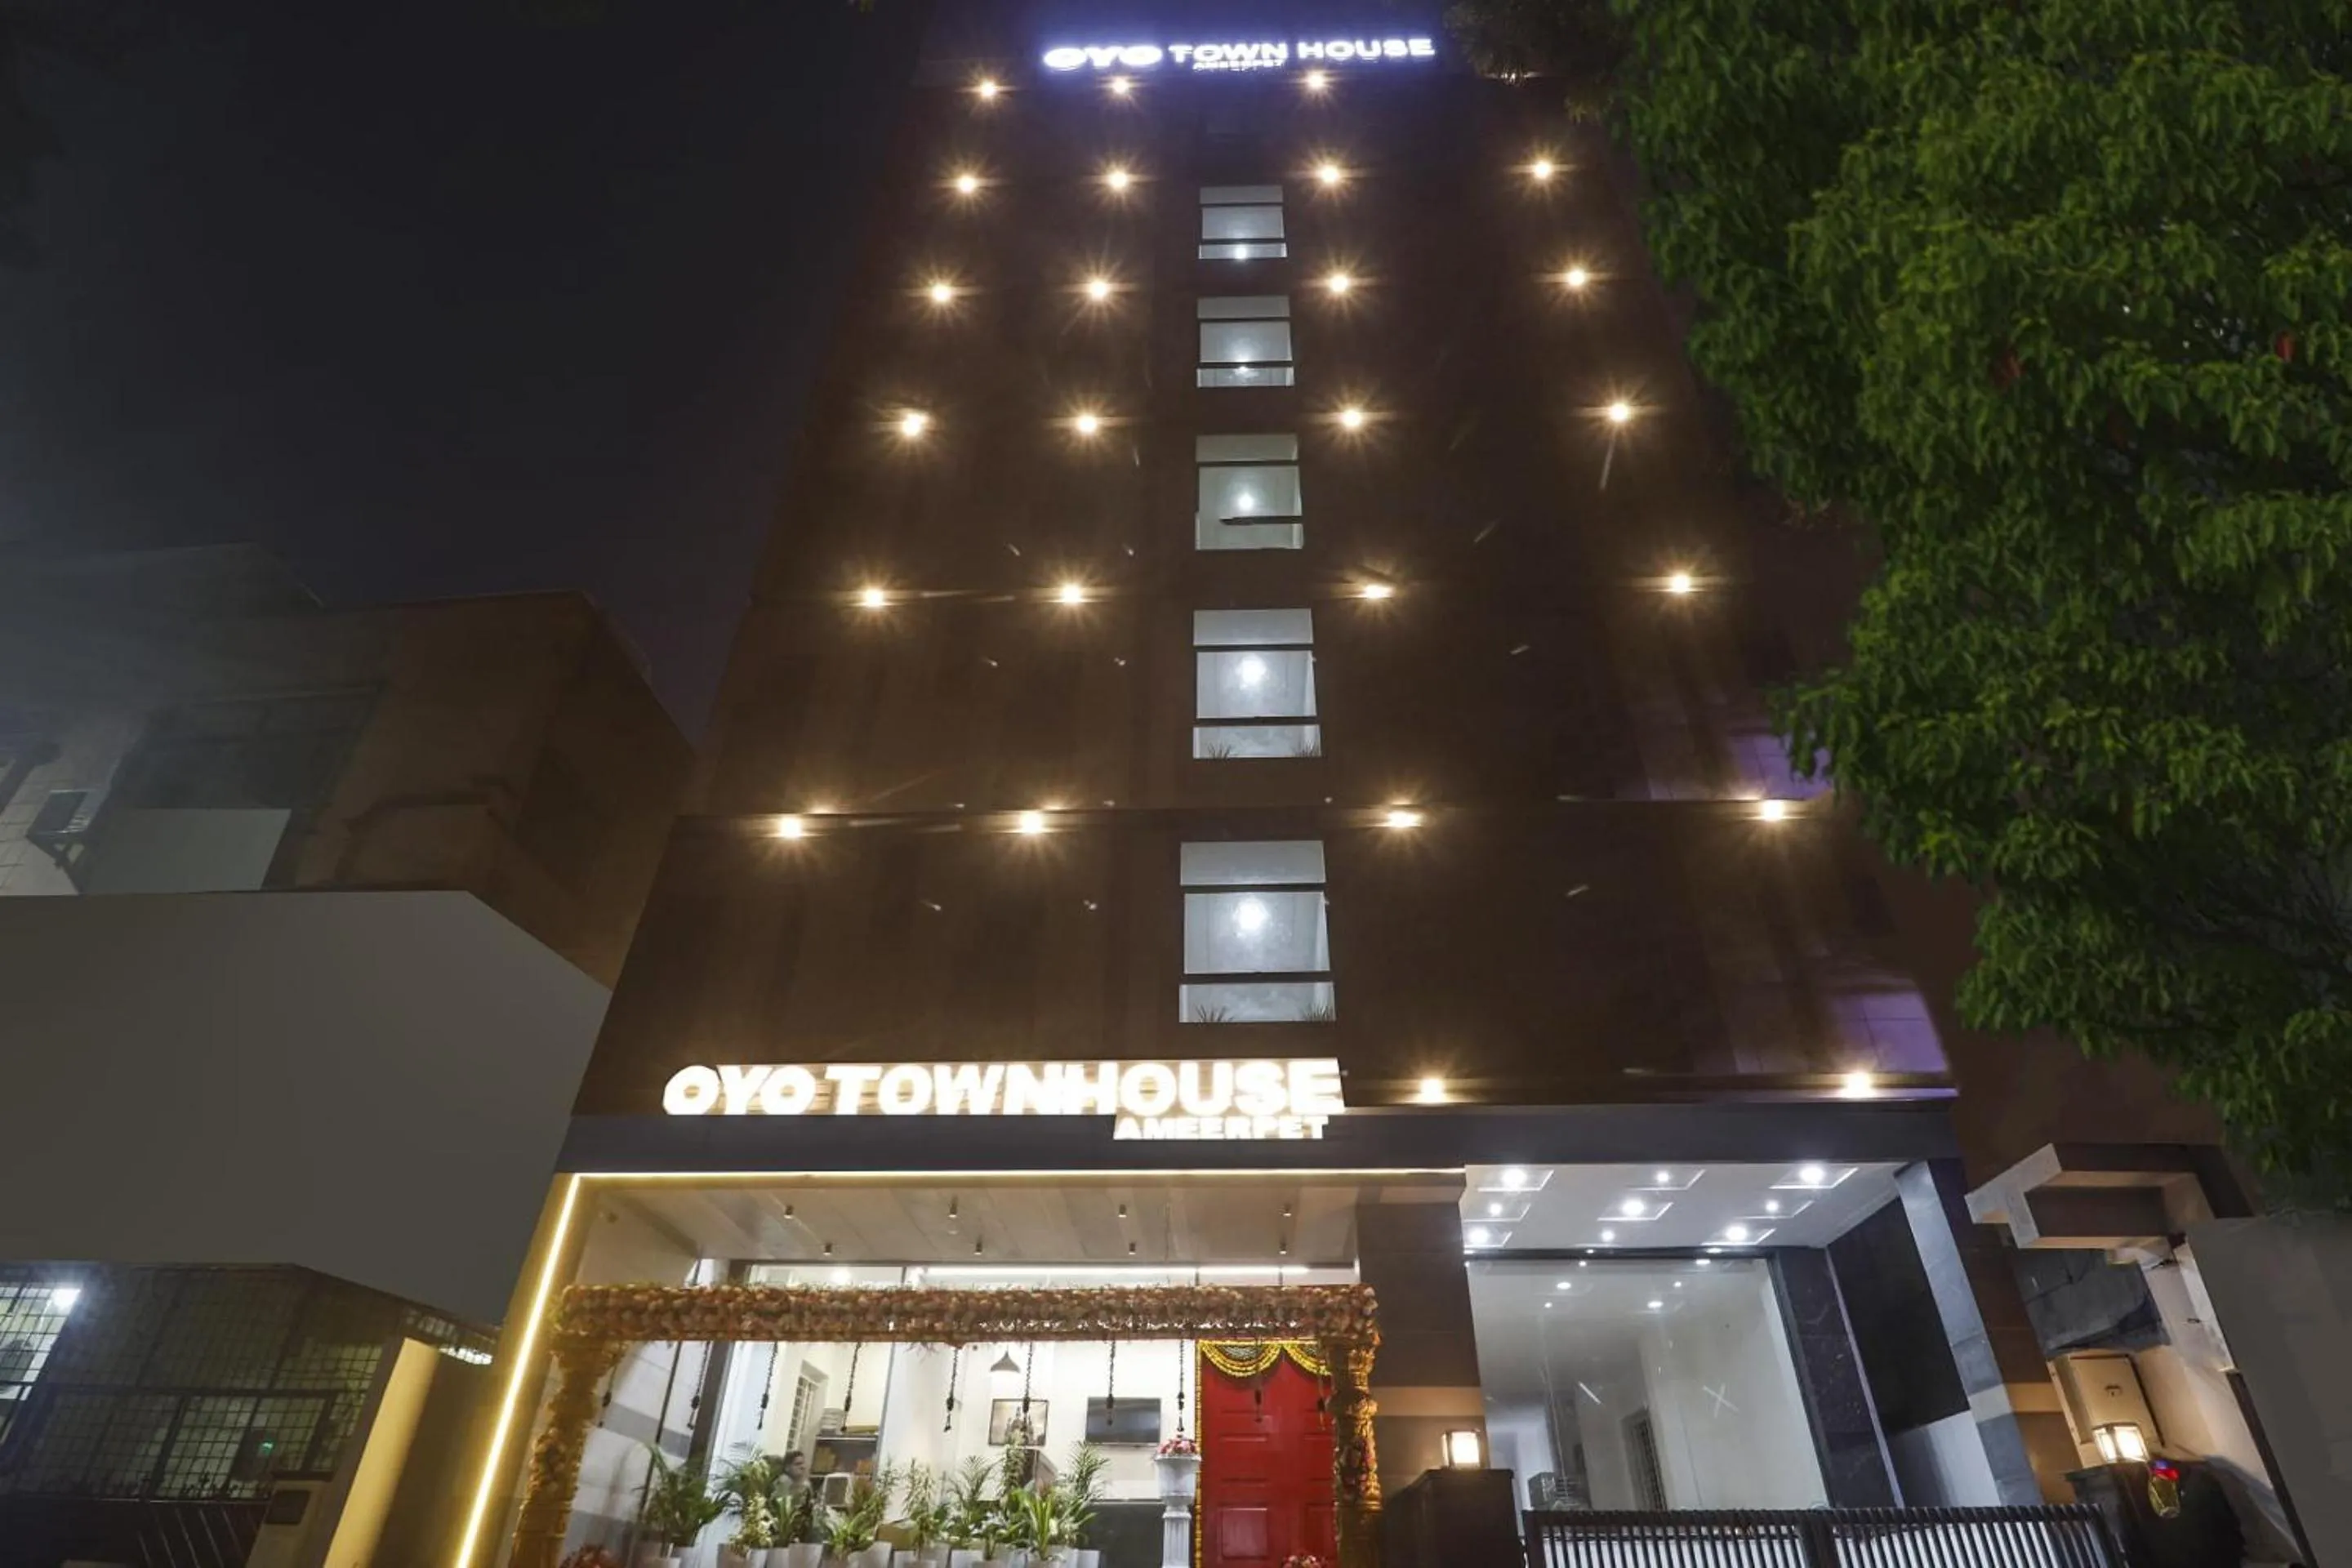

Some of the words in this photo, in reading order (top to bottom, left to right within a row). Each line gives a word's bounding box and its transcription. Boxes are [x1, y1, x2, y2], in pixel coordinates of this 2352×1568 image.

[1044, 46, 1162, 69] OYO
[1169, 42, 1288, 62] TOWN
[1298, 38, 1435, 59] HOUSE
[662, 1064, 817, 1115] OYO
[825, 1060, 1345, 1116] TOWNHOUSE
[1113, 1116, 1329, 1139] AMEERPET
